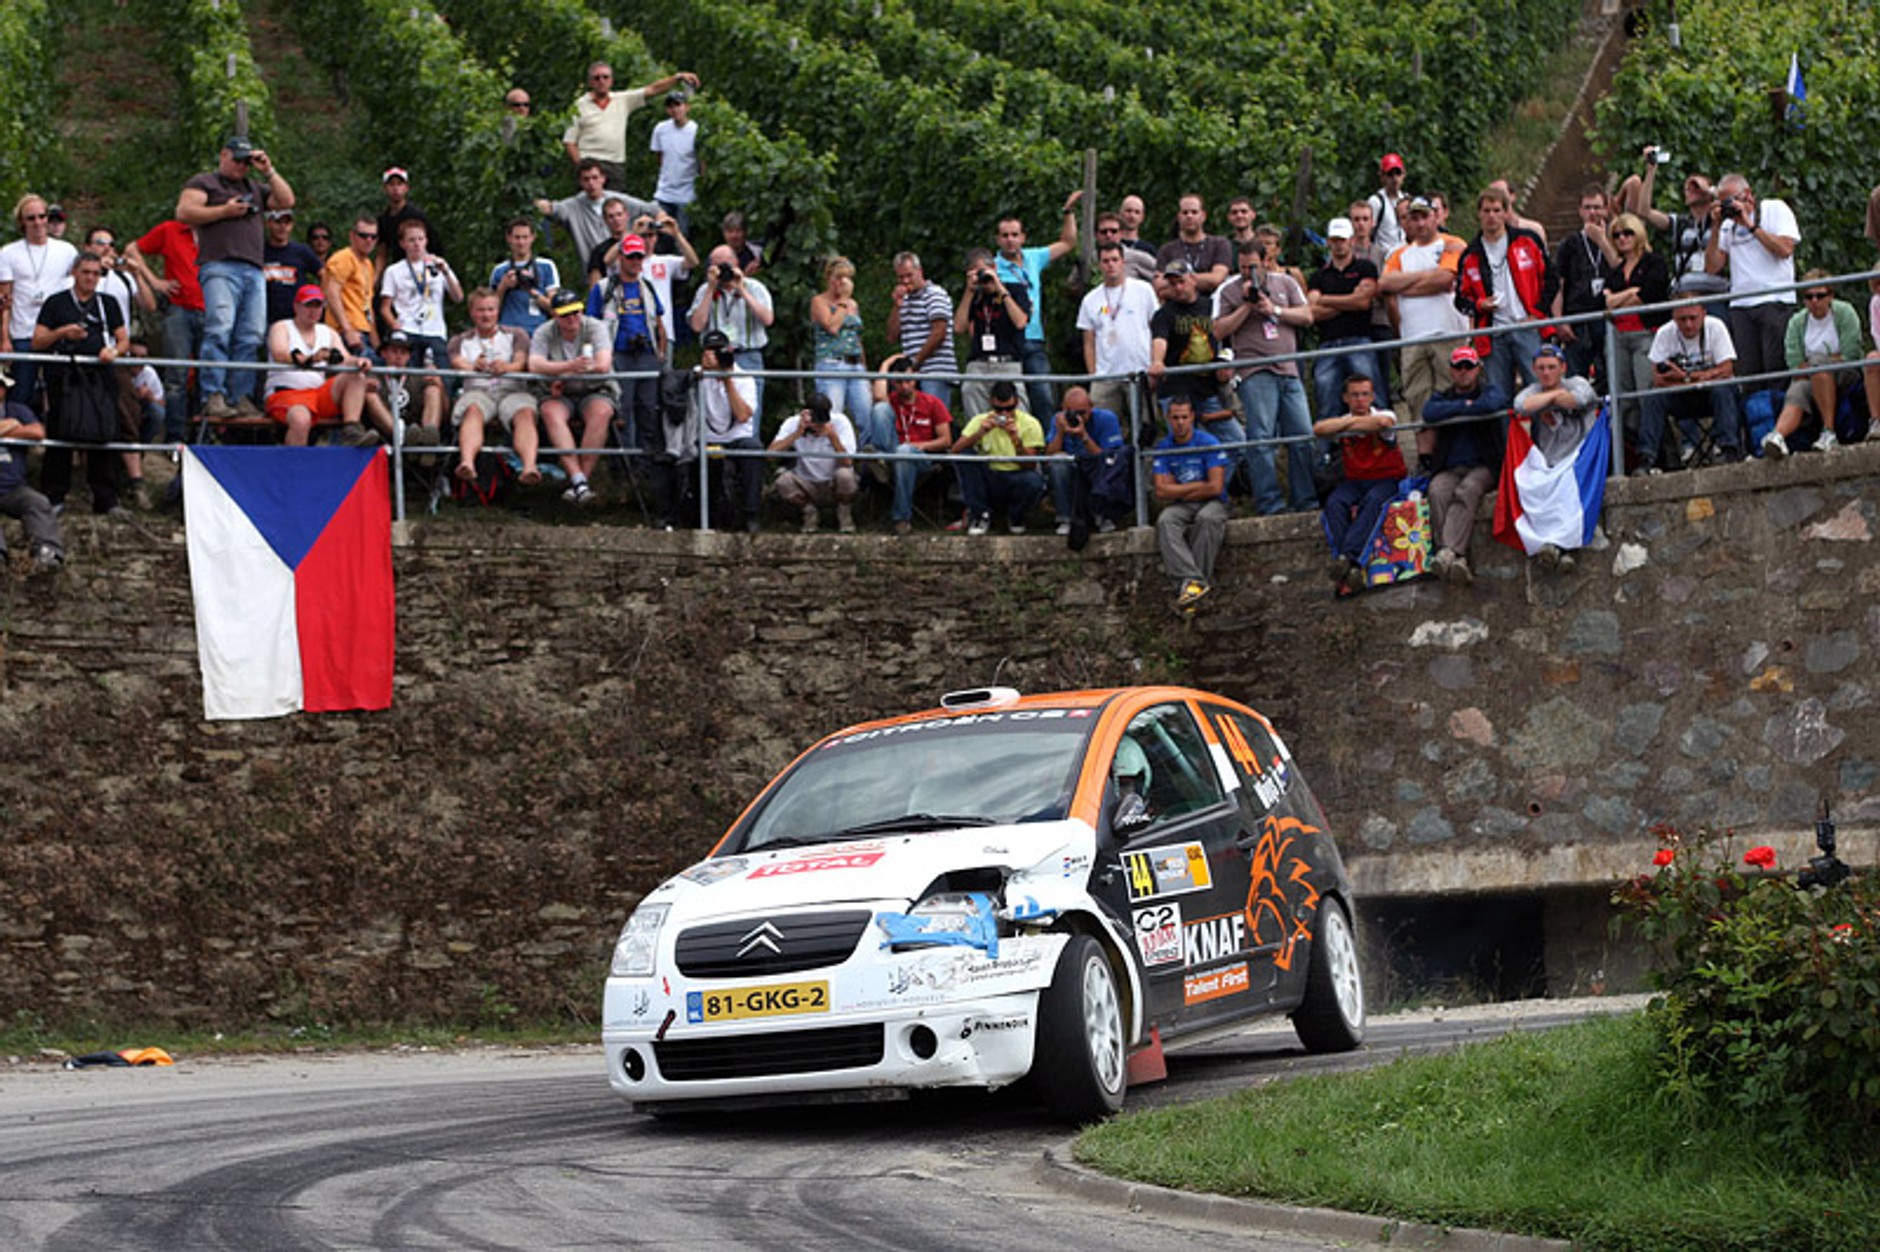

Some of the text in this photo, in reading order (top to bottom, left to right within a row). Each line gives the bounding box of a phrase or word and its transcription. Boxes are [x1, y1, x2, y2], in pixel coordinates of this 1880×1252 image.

[762, 856, 871, 875] TOTAL
[1130, 853, 1153, 897] 44
[1136, 906, 1176, 933] C2
[1183, 913, 1245, 967] KNAF
[1184, 976, 1219, 997] Talent
[1221, 969, 1247, 988] First
[706, 987, 826, 1016] 81-GKG-2
